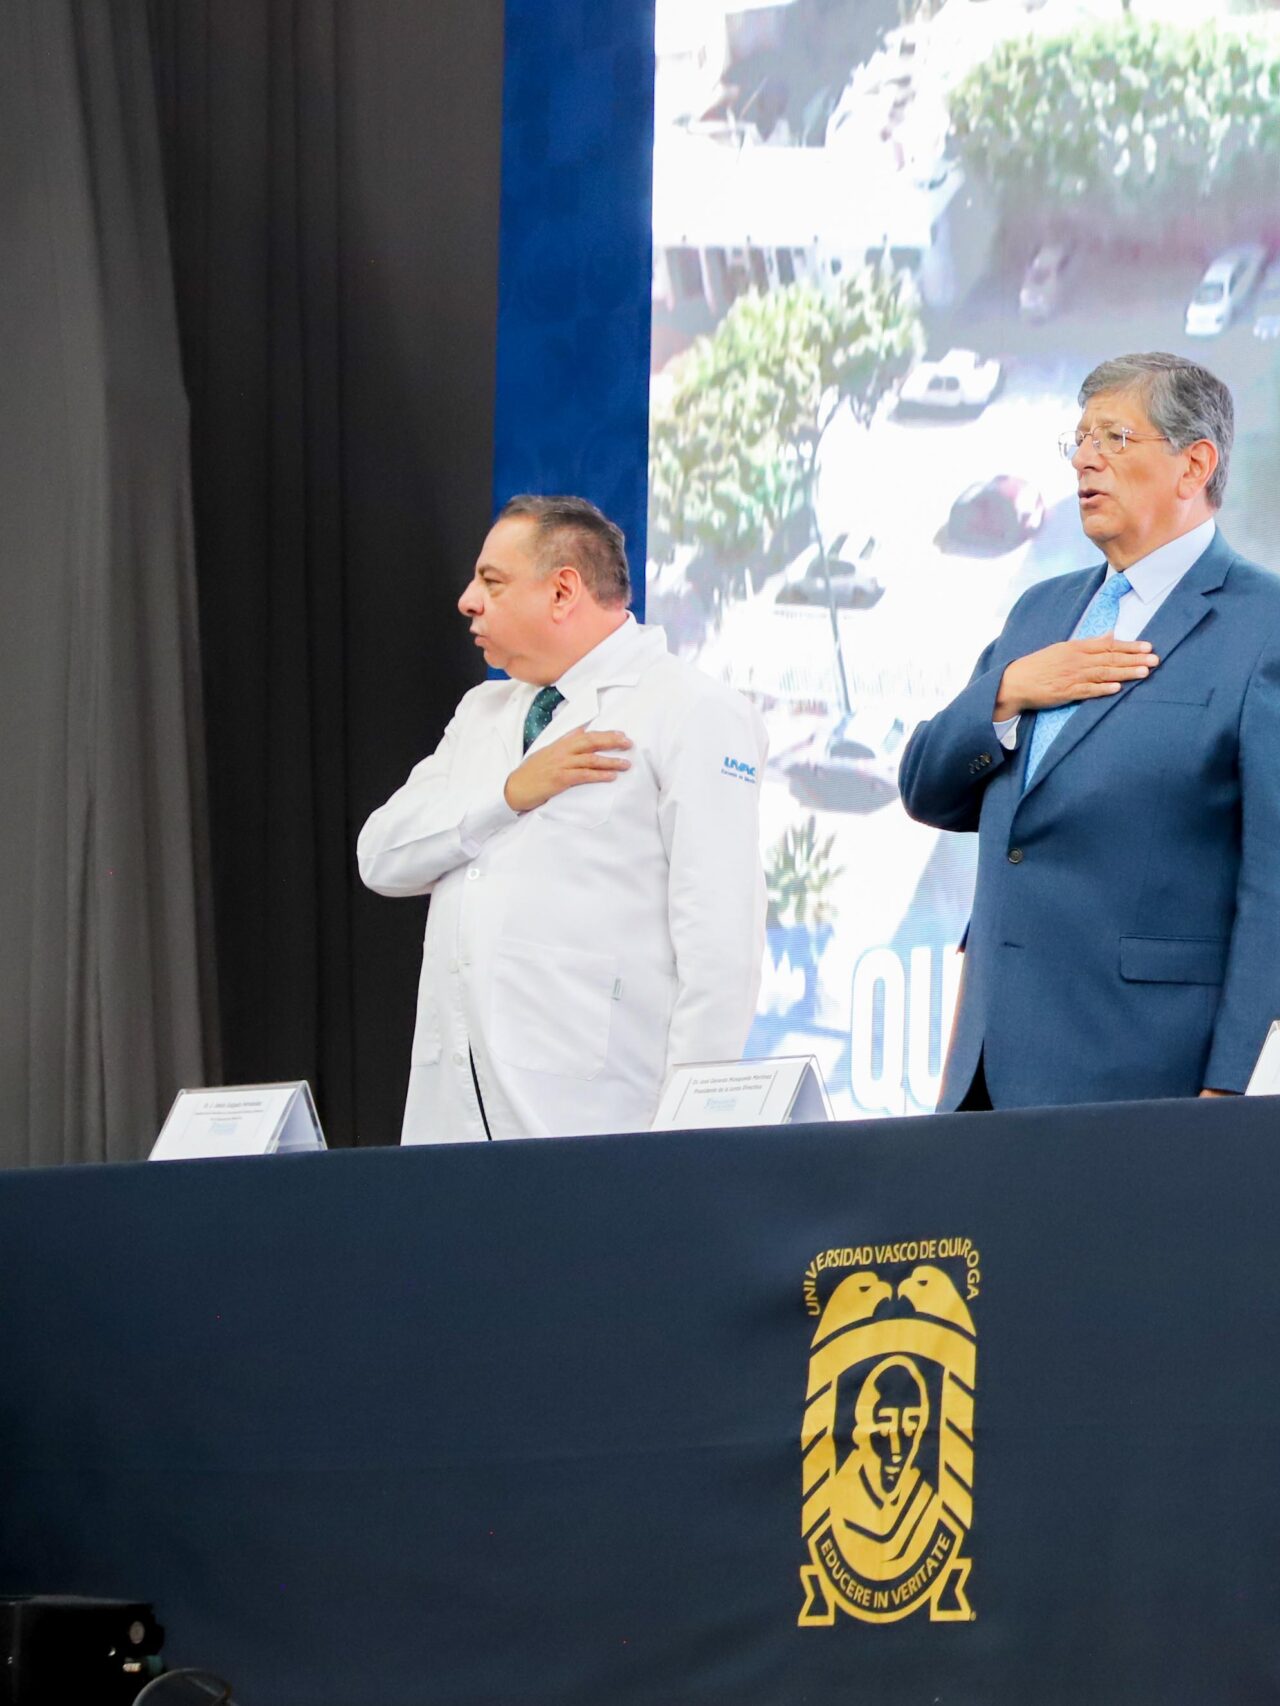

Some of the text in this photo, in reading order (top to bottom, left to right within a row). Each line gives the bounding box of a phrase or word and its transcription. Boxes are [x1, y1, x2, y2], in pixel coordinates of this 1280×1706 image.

[851, 944, 965, 1115] QU
[803, 1237, 981, 1316] UNIVERSIDAD VASCO DE QUIROGA
[820, 1532, 950, 1609] EDUCERE IN VERITATE
